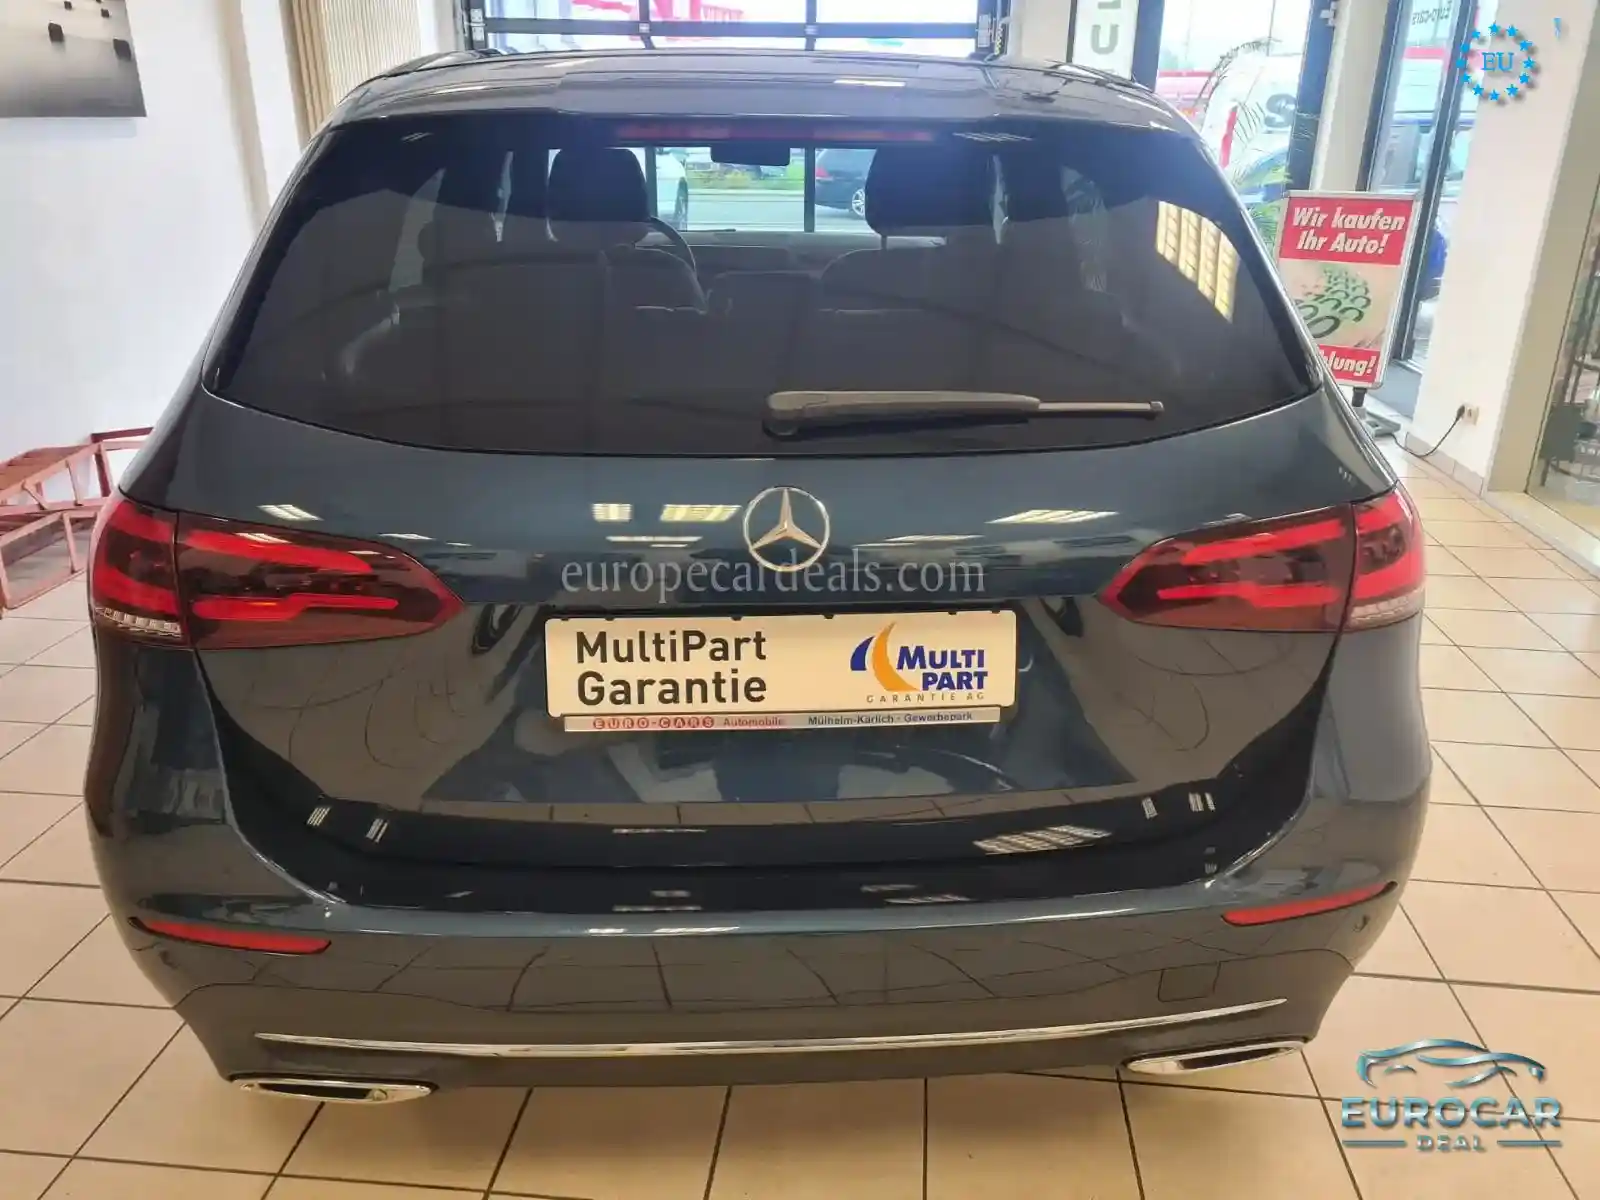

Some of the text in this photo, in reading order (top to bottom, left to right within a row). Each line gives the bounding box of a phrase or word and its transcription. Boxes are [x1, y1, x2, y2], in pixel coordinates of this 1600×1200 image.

[1293, 206, 1406, 231] Wir kaufen
[1297, 229, 1389, 254] Ihr Auto!
[576, 630, 767, 664] MultiPart
[577, 668, 767, 706] Garantie
[922, 671, 988, 691] PART
[866, 692, 985, 703] GARANTIE AG
[592, 716, 715, 731] EURO-CARS
[723, 716, 785, 728] Automobile
[904, 712, 973, 724] Gewerbepark
